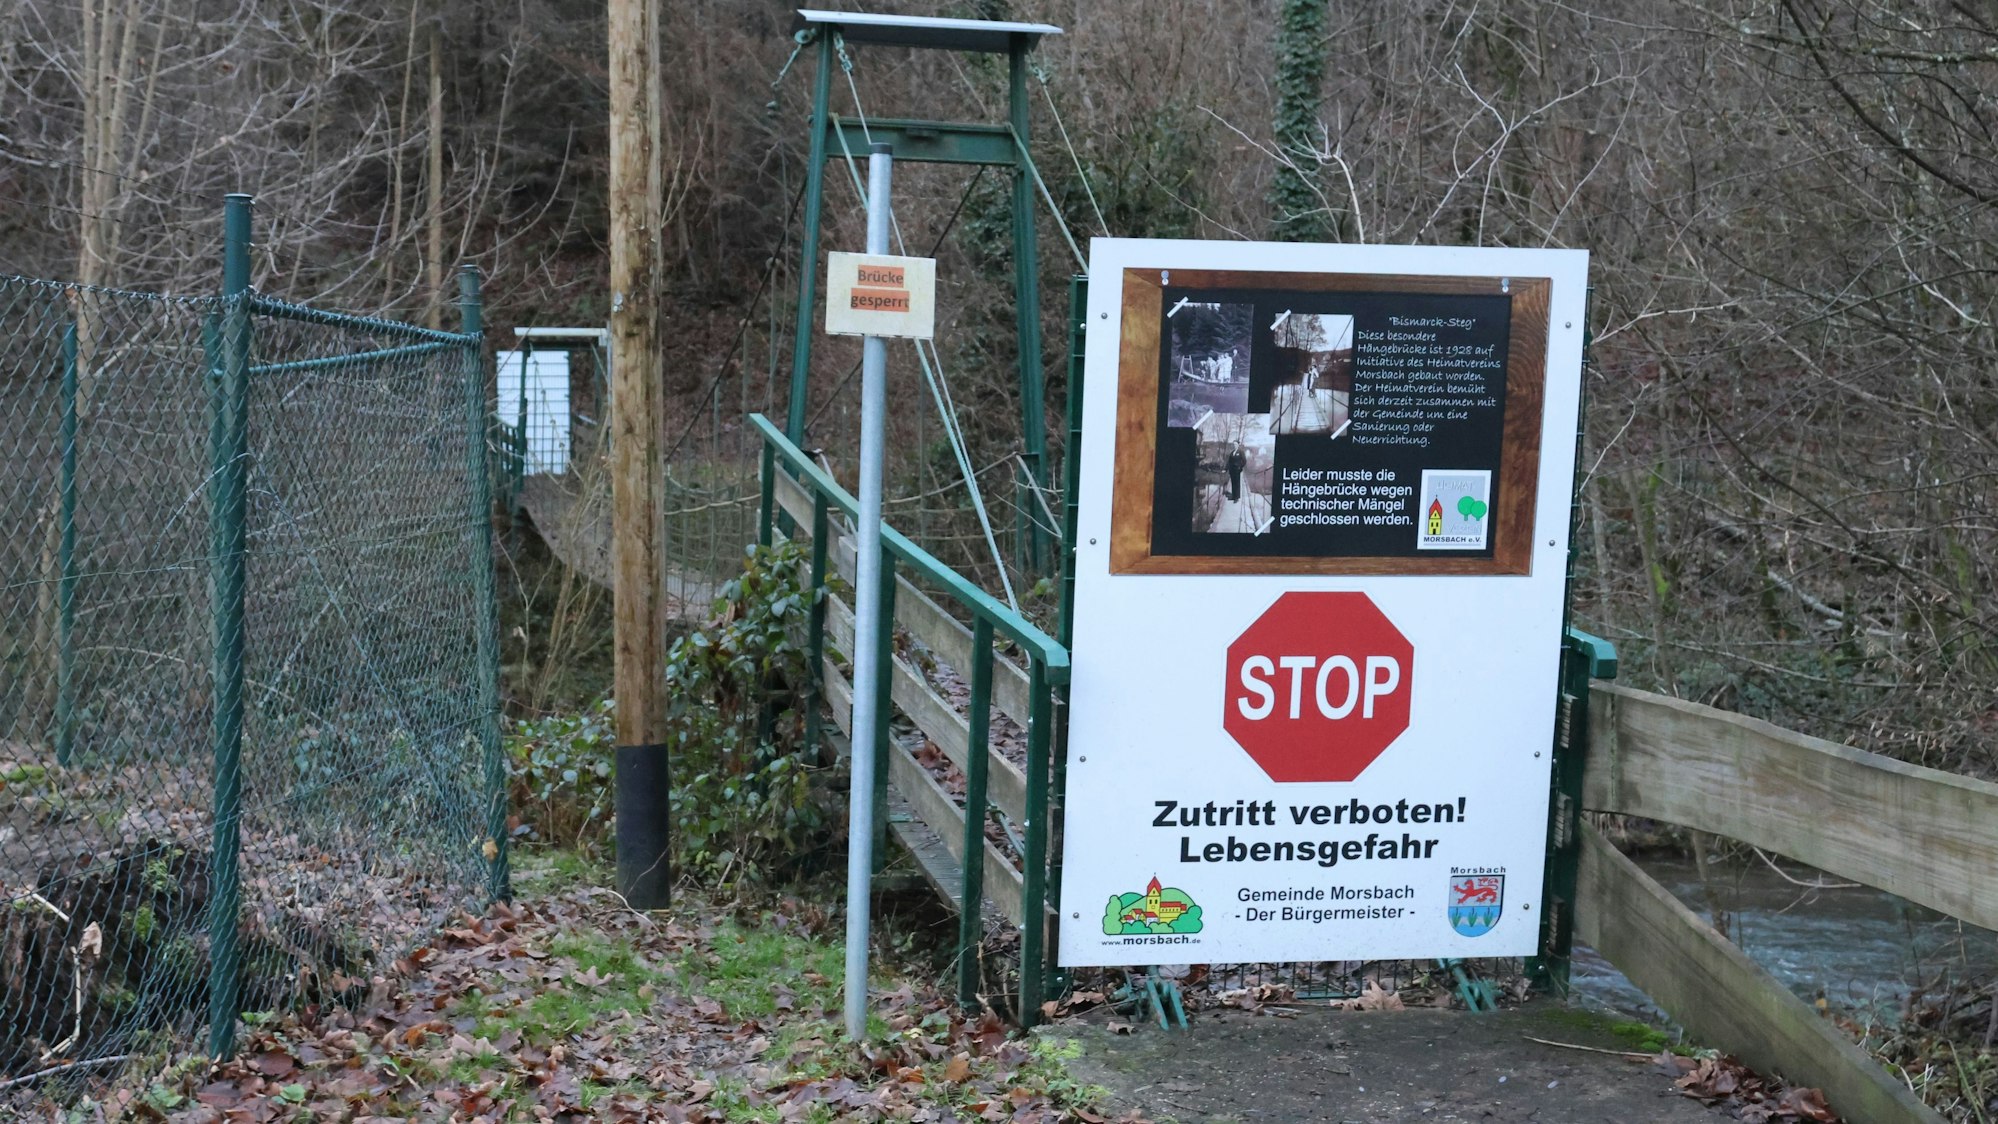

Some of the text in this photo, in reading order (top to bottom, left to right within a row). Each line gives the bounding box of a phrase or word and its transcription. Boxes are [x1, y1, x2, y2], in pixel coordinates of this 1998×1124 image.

[859, 270, 904, 284] Brücke
[851, 295, 909, 309] gesperrt
[1358, 331, 1436, 341] Diese besondere
[1358, 344, 1495, 357] Hängebrücke ist 1928 auf
[1357, 358, 1501, 368] Initiative des Heimatvereins
[1356, 370, 1485, 382] Morsbach gebaut worden.
[1355, 383, 1485, 393] Der Heimatverein bemüht
[1354, 396, 1496, 406] sich derzeit zusammen mit
[1353, 410, 1369, 418] der
[1373, 409, 1424, 419] Gemeinde
[1447, 411, 1468, 419] eine
[1352, 422, 1434, 434] Sanierung oder
[1352, 435, 1430, 447] Neuerrichtung.
[1283, 468, 1395, 481] Leider musste die
[1282, 483, 1412, 498] Hängebrücke wegen
[1281, 498, 1405, 513] technischer Mängel
[1280, 513, 1413, 527] geschlossen werden.
[1237, 654, 1400, 720] STOP
[1152, 797, 1466, 827] Zutritt verboten!
[1179, 835, 1439, 867] Lebensgefahr
[1451, 866, 1506, 874] Morsbach
[1238, 885, 1414, 901] Gemeinde Morsbach
[1246, 908, 1276, 921] Der
[1282, 905, 1404, 923] Bürgermeister
[1101, 935, 1200, 945] www.morsbach.de
